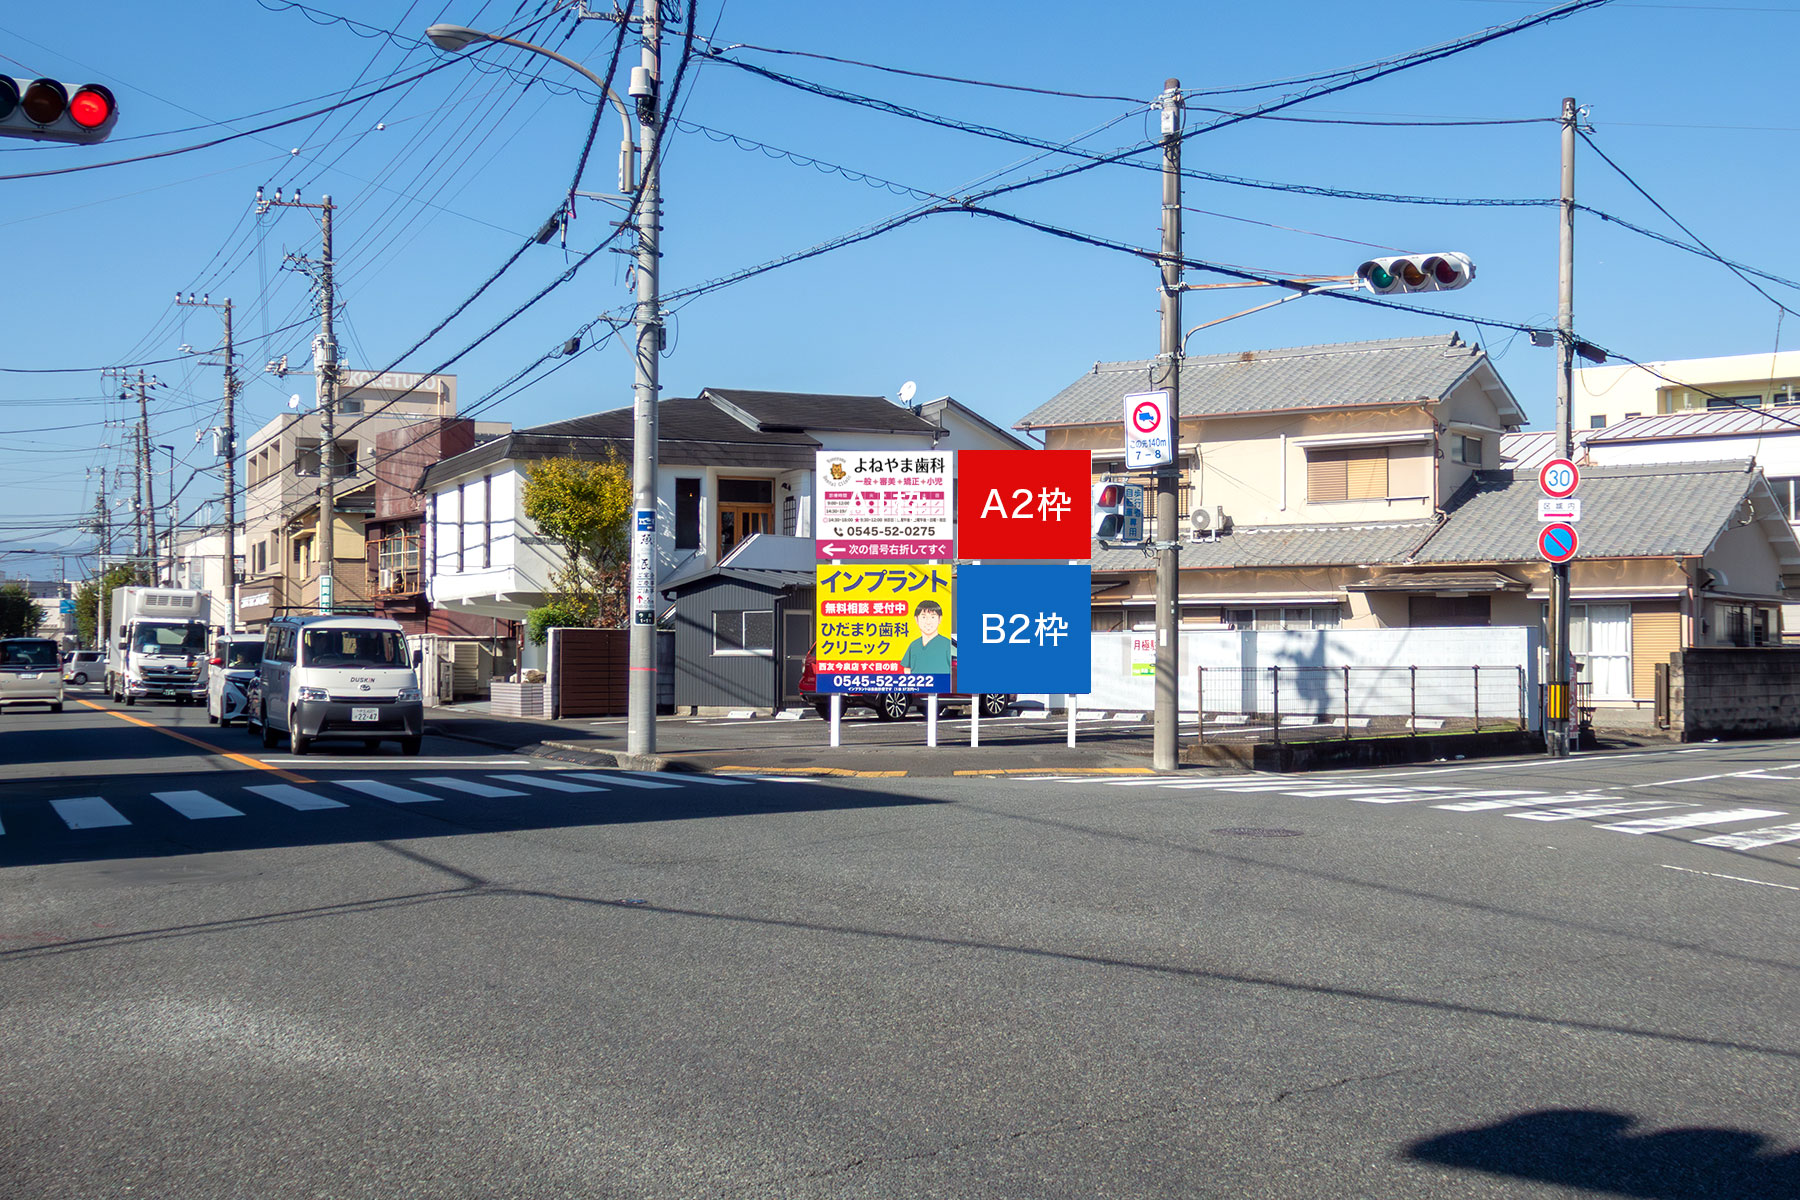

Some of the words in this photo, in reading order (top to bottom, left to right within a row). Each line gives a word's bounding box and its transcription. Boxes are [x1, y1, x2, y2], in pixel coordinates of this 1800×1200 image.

[1129, 438, 1167, 449] この先140m
[854, 458, 945, 474] よねやま歯科
[1548, 470, 1570, 487] 30
[847, 527, 935, 536] 0545-52-0275
[849, 544, 946, 555] 次の信号右折してすぐ
[821, 569, 948, 593] インプラント
[825, 603, 869, 614] 無料相談
[873, 603, 906, 614] 受付中
[821, 622, 909, 637] ひだまり歯科
[821, 640, 890, 655] クリニック
[861, 662, 898, 671] すぐ目の前
[833, 676, 934, 687] 0545-52-2222
